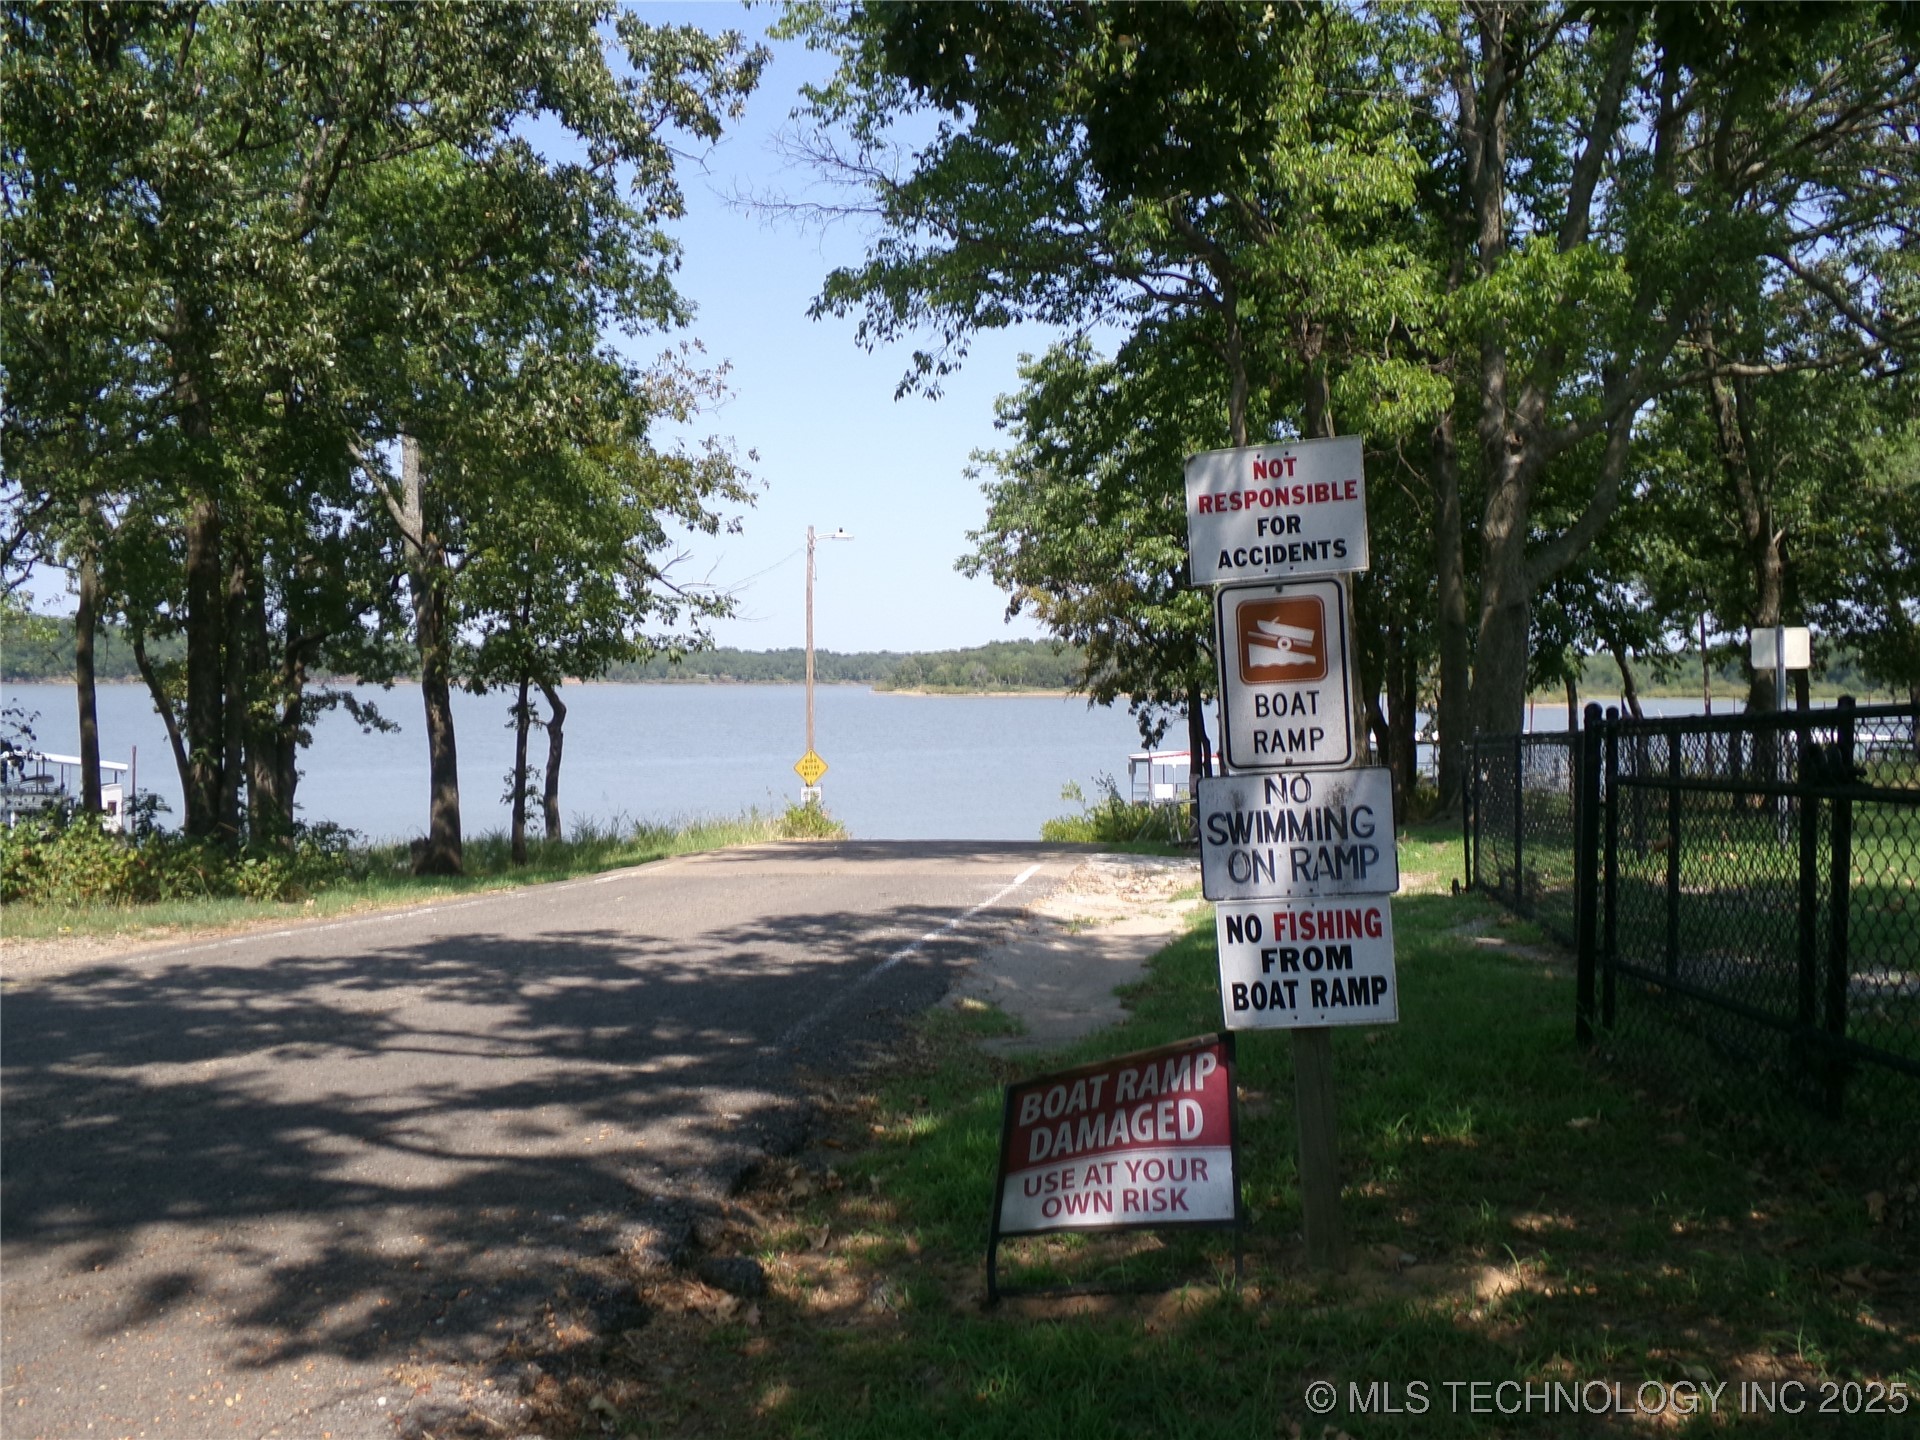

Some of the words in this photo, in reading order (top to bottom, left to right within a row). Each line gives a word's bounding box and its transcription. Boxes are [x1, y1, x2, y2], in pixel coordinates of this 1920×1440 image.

[1253, 457, 1297, 480] NOT
[1198, 480, 1358, 514] RESPONSIBLE
[1257, 514, 1301, 537] FOR
[1218, 538, 1347, 569] ACCIDENTS
[1255, 690, 1320, 718] BOAT
[1253, 727, 1324, 754] RAMP
[1264, 776, 1312, 804] NO
[1207, 805, 1376, 846] SWIMMING
[1228, 848, 1276, 884] ON
[1290, 844, 1380, 882] RAMP
[1226, 913, 1262, 944] NO
[1273, 907, 1383, 942] FISHING
[1261, 944, 1353, 974] FROM
[1231, 979, 1299, 1011] BOAT
[1310, 975, 1388, 1008] RAMP
[1019, 1074, 1109, 1126] BOAT
[1115, 1052, 1217, 1104] RAMP
[1028, 1098, 1204, 1163] DAMAGED
[1023, 1168, 1076, 1197] USE
[1084, 1161, 1118, 1187] AT
[1125, 1157, 1209, 1184] YOUR
[1041, 1190, 1113, 1218] OWN
[1122, 1187, 1189, 1213] RISK
